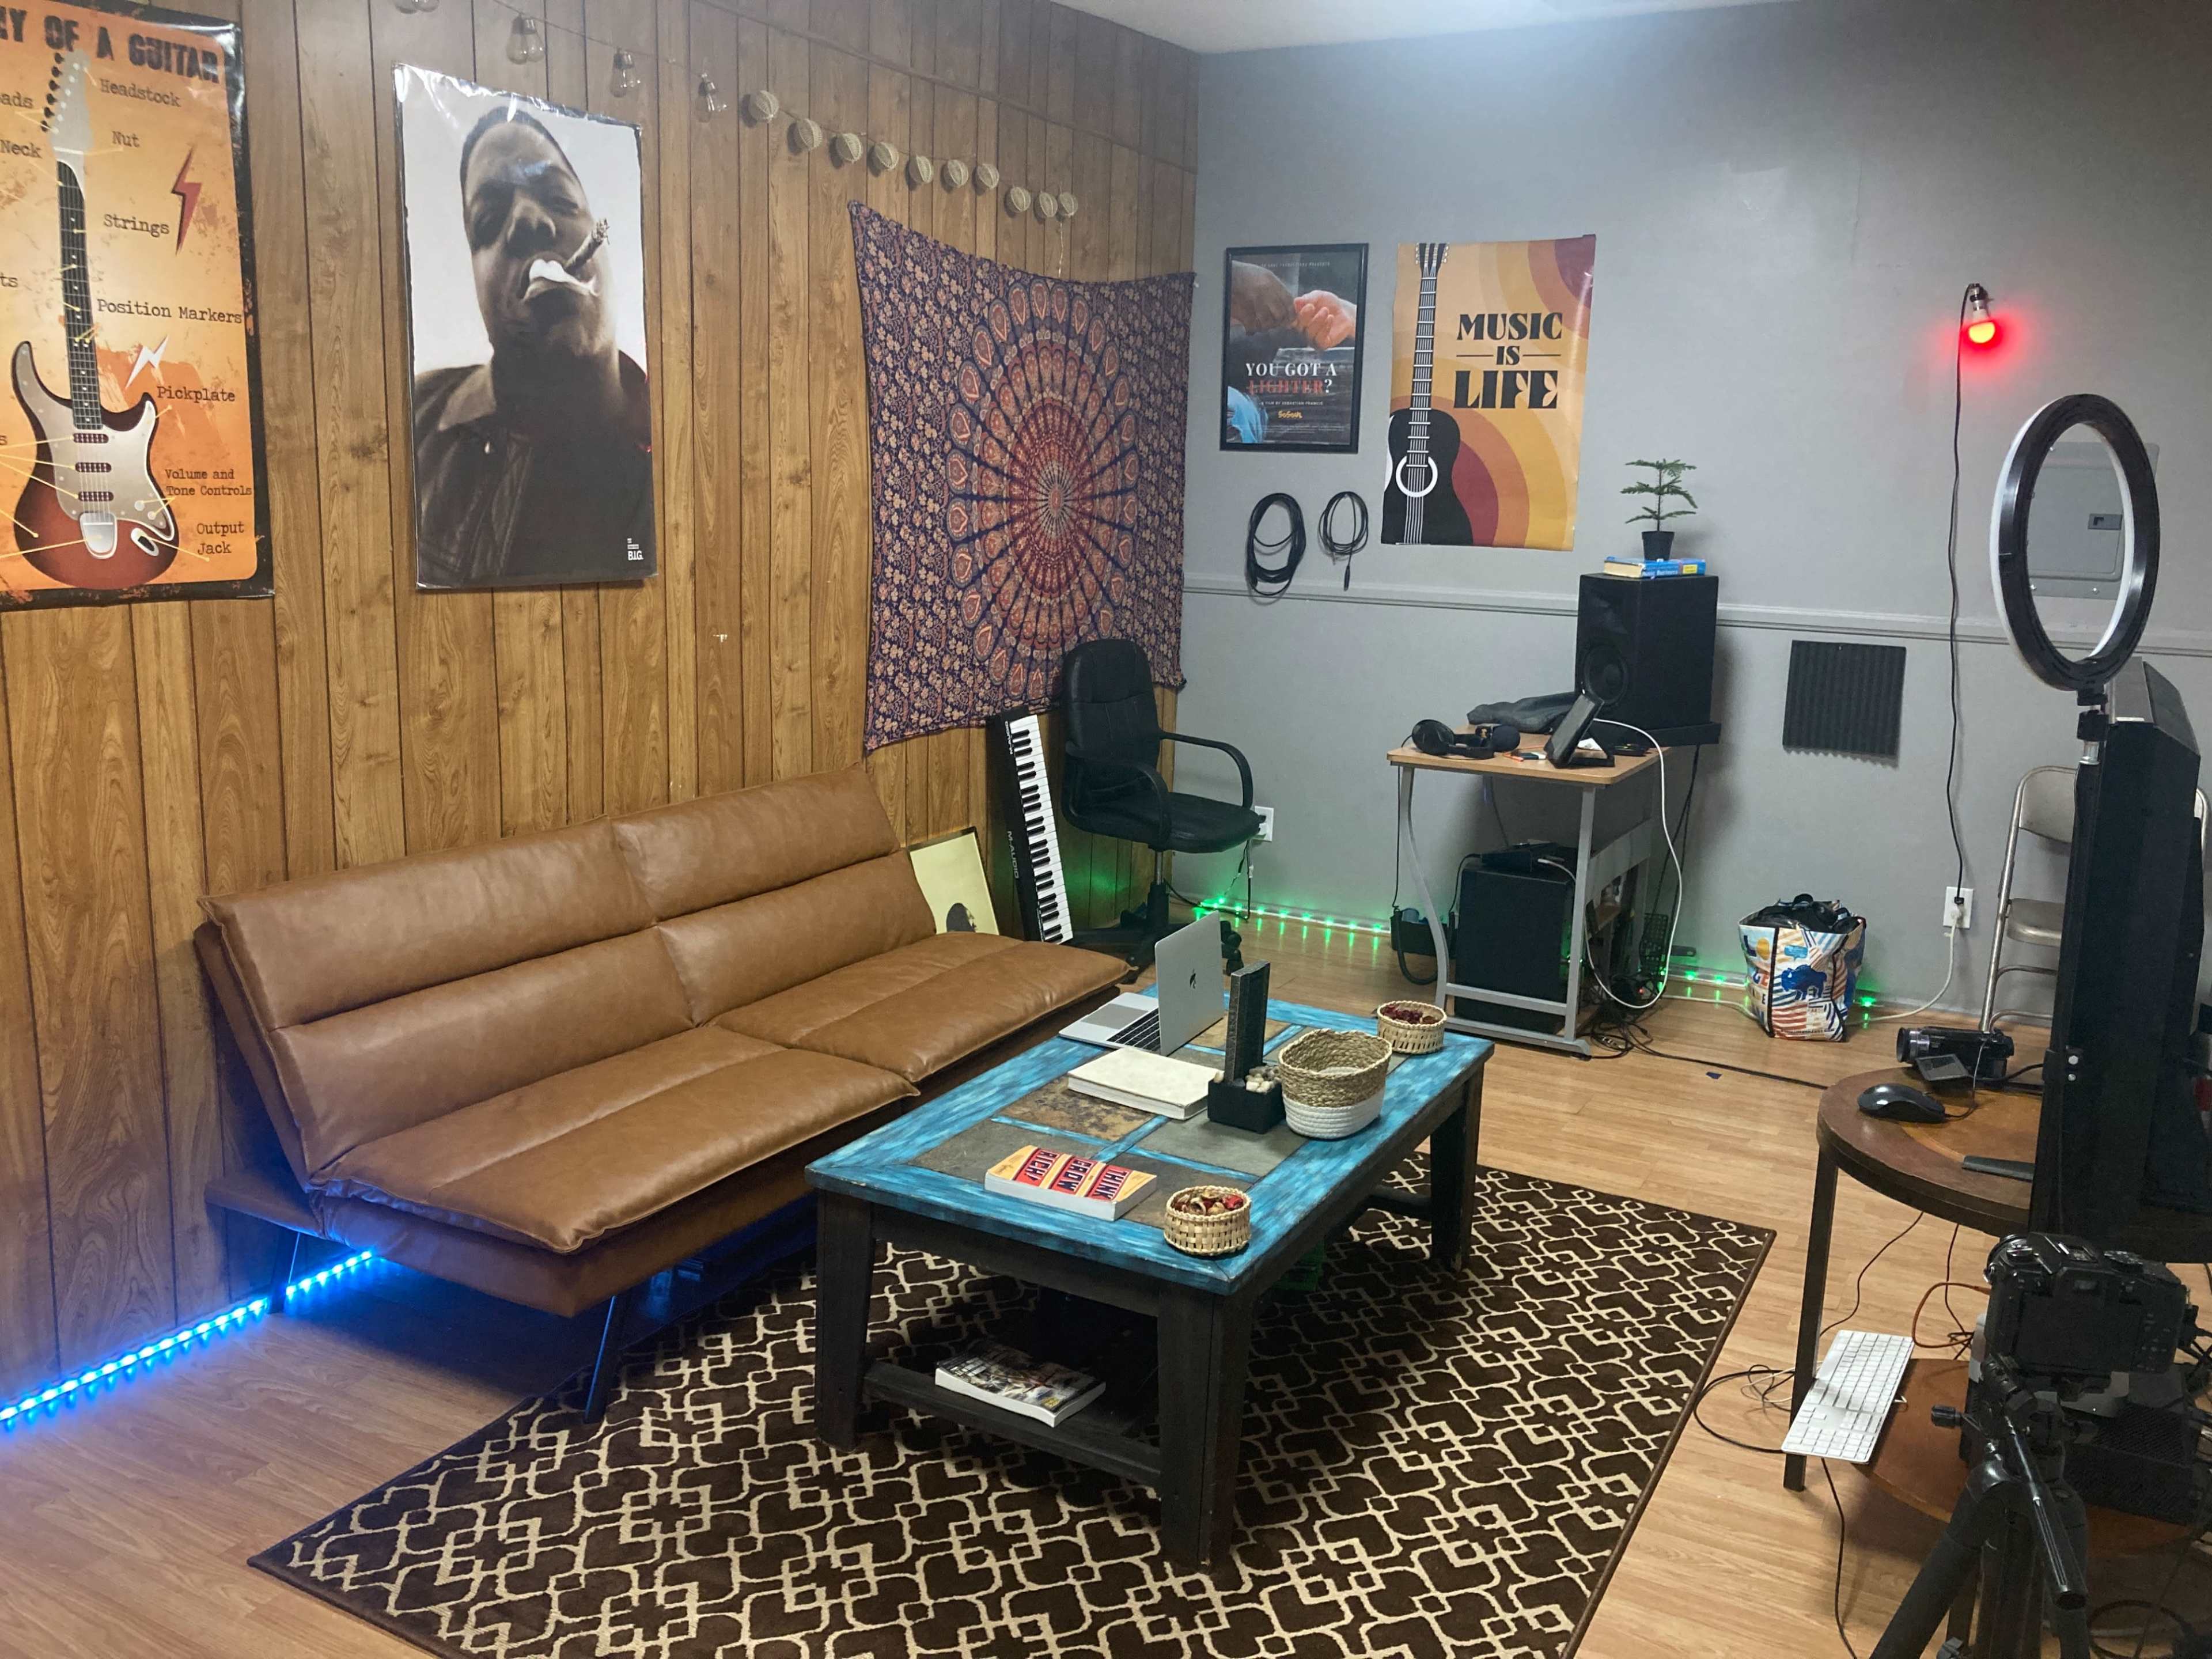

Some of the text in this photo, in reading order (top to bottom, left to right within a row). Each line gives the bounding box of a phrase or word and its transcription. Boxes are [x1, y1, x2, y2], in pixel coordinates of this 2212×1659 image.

[44, 16, 79, 52] OF
[96, 26, 114, 61] A
[129, 33, 219, 84] GUITAR
[100, 79, 181, 108] Headstock
[0, 139, 43, 158] Neck
[112, 131, 140, 148] Nut
[104, 214, 169, 237] Strings
[97, 298, 243, 324] Position Markers
[1456, 312, 1563, 340] MUSIC
[1496, 346, 1520, 365] IS
[1245, 363, 1337, 376] YOU GOT A
[157, 386, 236, 403] Pickplate
[1454, 370, 1558, 409] LIFE
[165, 469, 234, 480] Volume and
[166, 486, 252, 495] Tone Controls
[197, 522, 244, 537] Output
[198, 542, 232, 555] Jack
[1007, 831, 1019, 878] M-AUDIO
[1056, 1158, 1093, 1192] GROW
[1091, 1168, 1128, 1200] THINK
